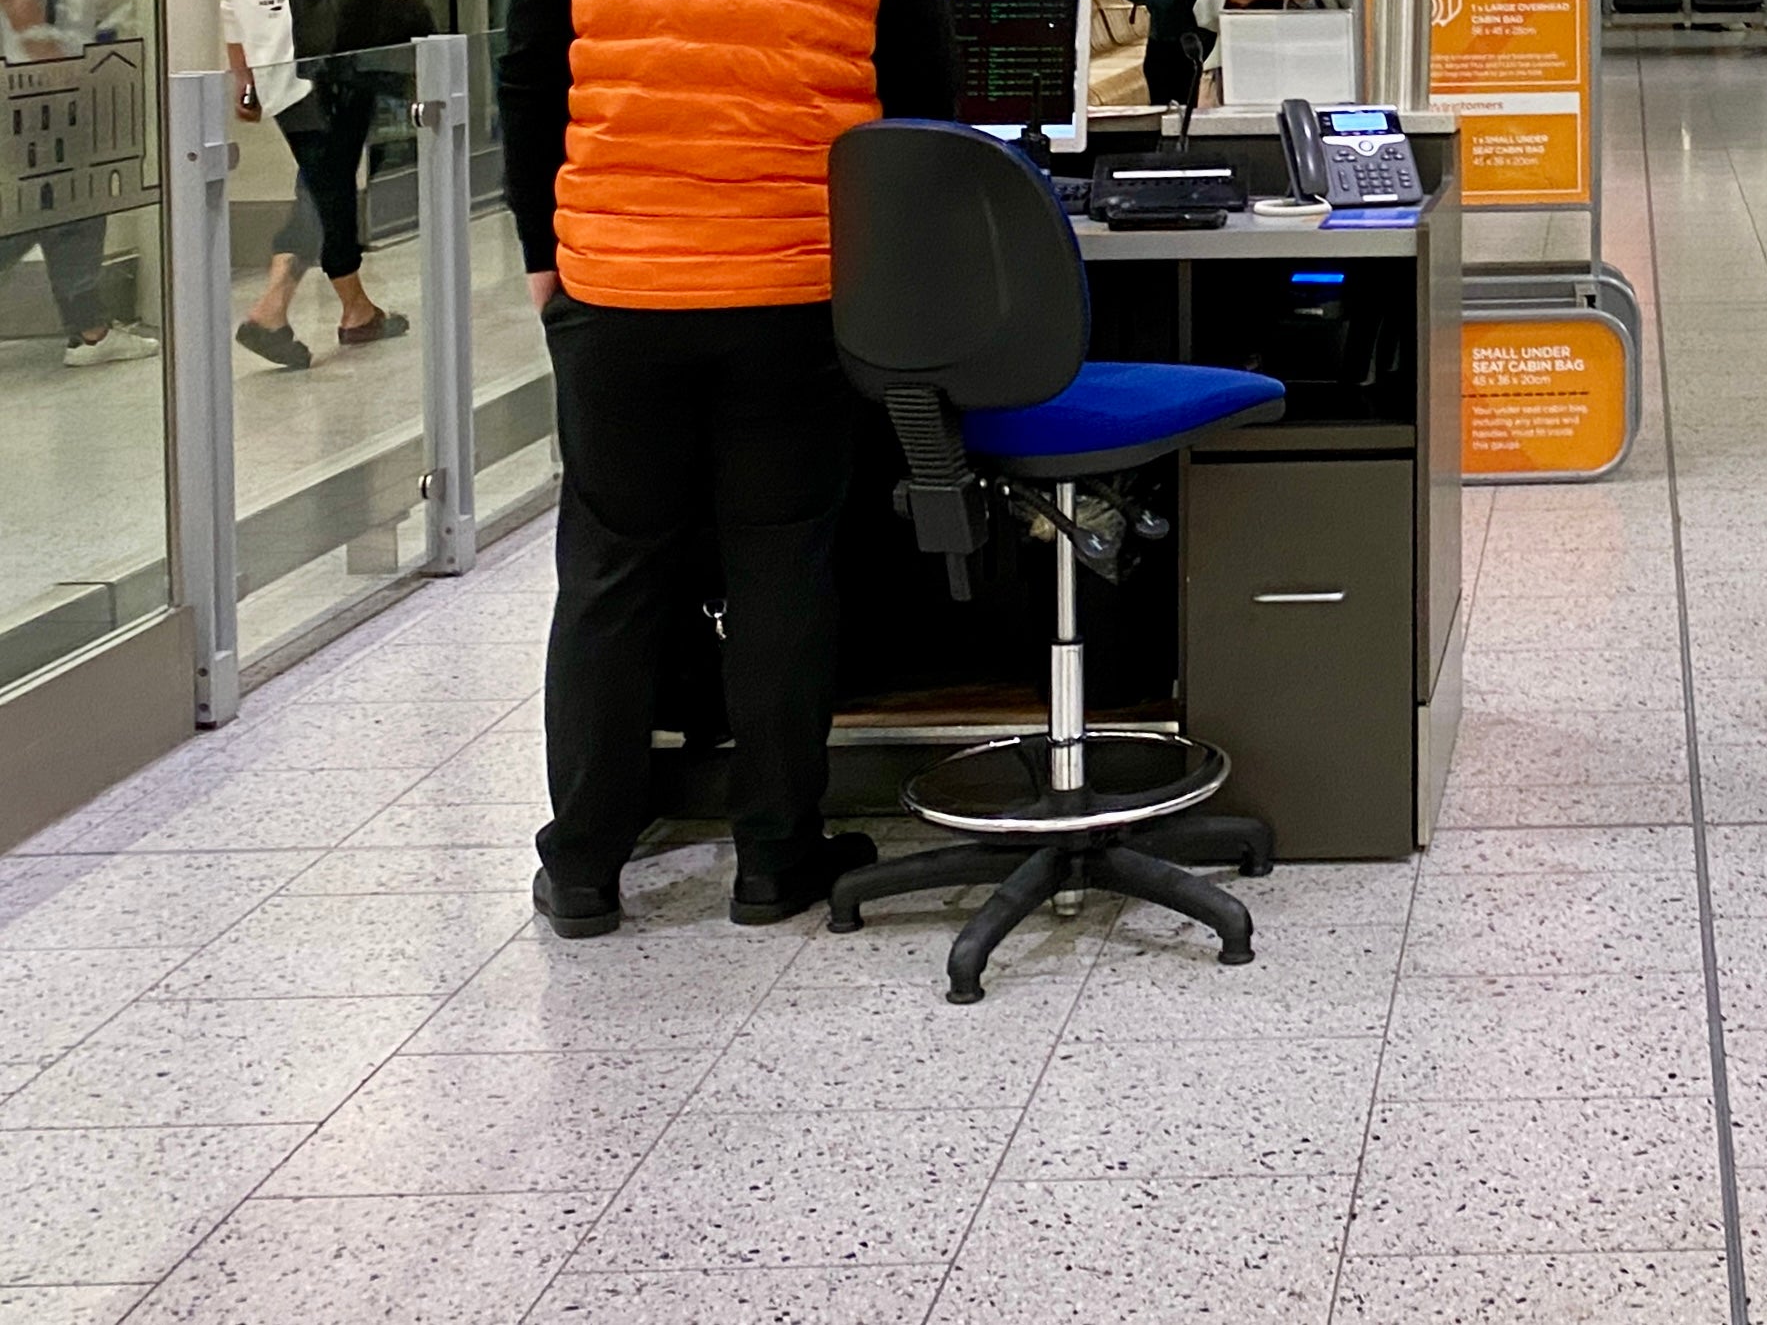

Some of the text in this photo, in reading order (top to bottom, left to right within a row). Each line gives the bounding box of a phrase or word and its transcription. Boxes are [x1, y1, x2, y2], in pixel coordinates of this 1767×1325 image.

[1472, 346, 1571, 360] SMALL UNDER
[1472, 359, 1585, 373] SEAT CABIN BAG
